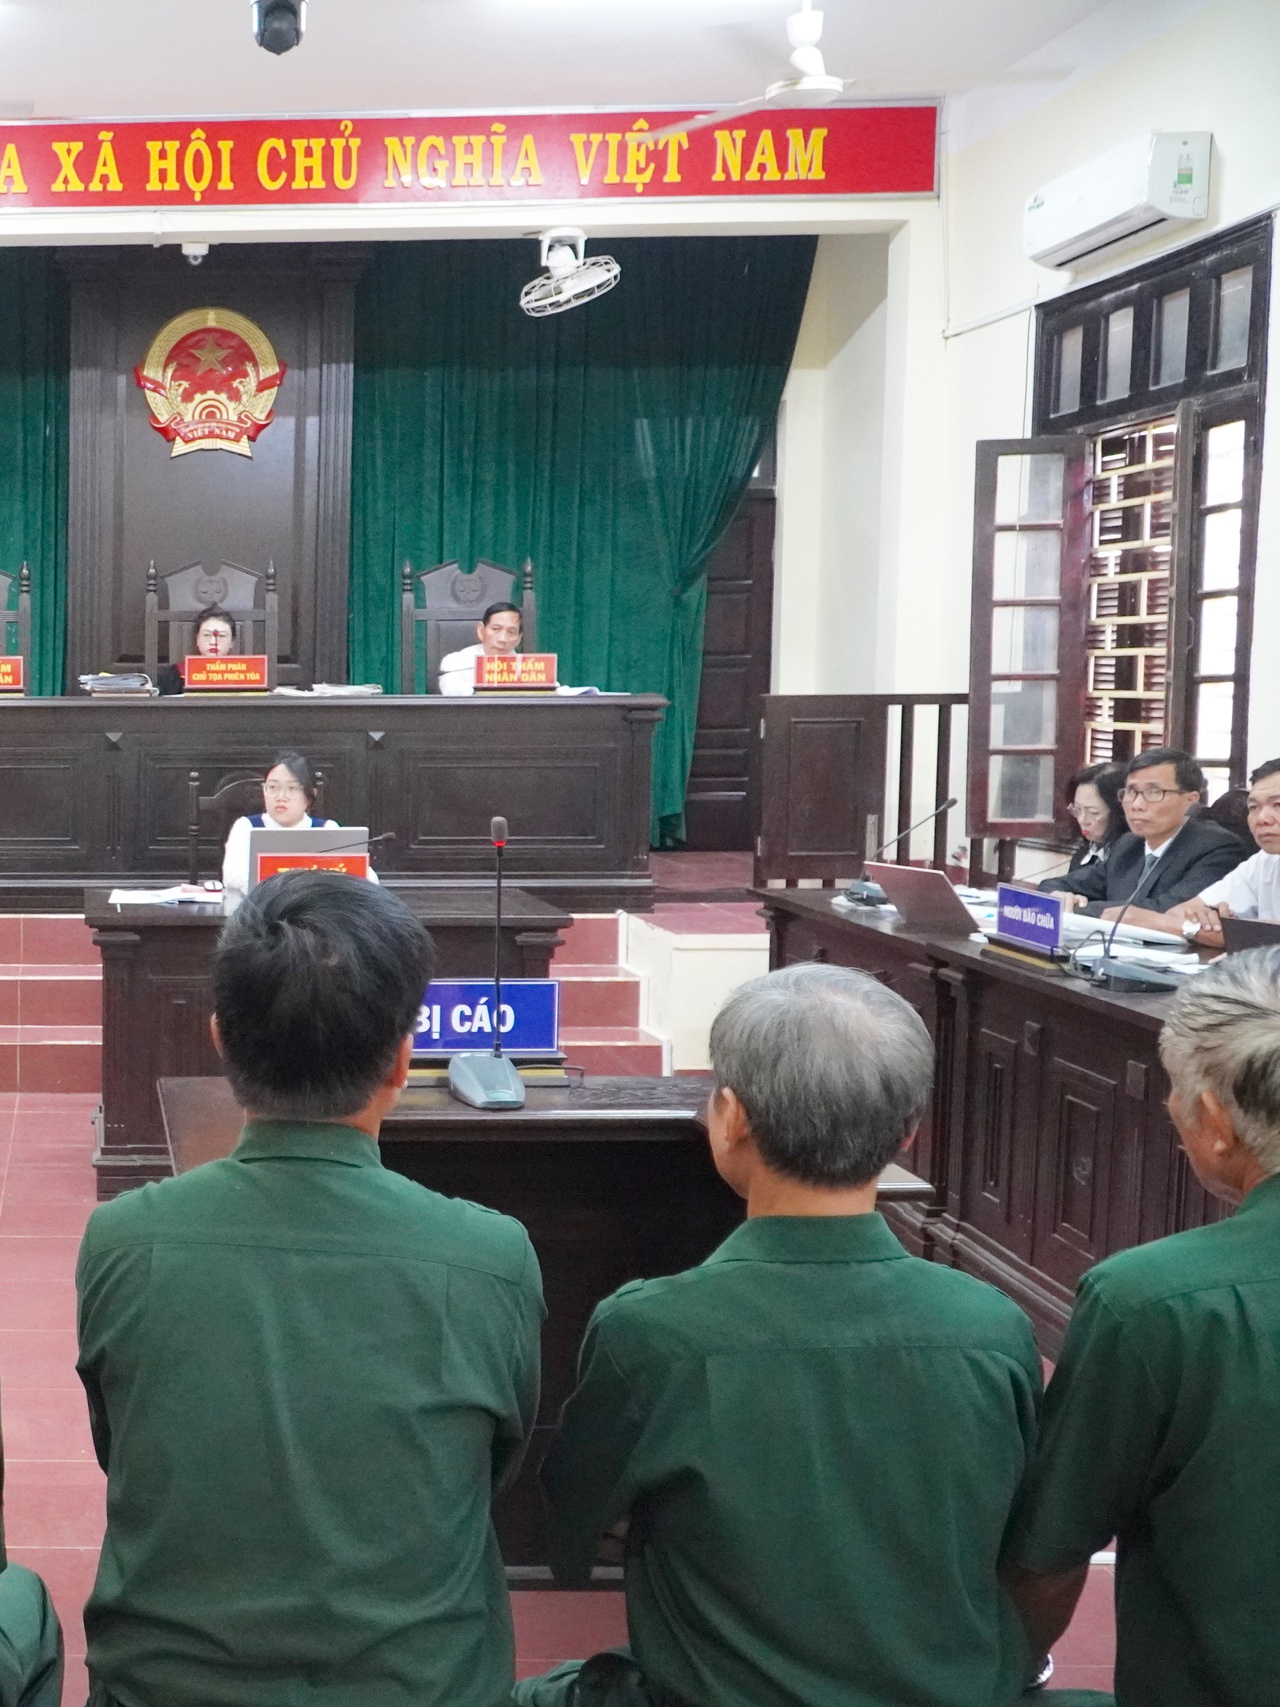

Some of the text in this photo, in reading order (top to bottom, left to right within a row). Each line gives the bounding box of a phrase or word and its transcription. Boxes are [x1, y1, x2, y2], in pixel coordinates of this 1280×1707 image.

[50, 131, 124, 192] XÃ
[145, 128, 234, 201] HỘI
[256, 120, 362, 190] CHỦ
[383, 123, 545, 188] NGHĨA
[569, 117, 690, 194] VIỆT
[711, 127, 828, 182] NAM
[485, 671, 546, 682] NHÂN DÂN
[486, 660, 508, 672] HỘI
[416, 997, 516, 1039] BỊ CÁO
